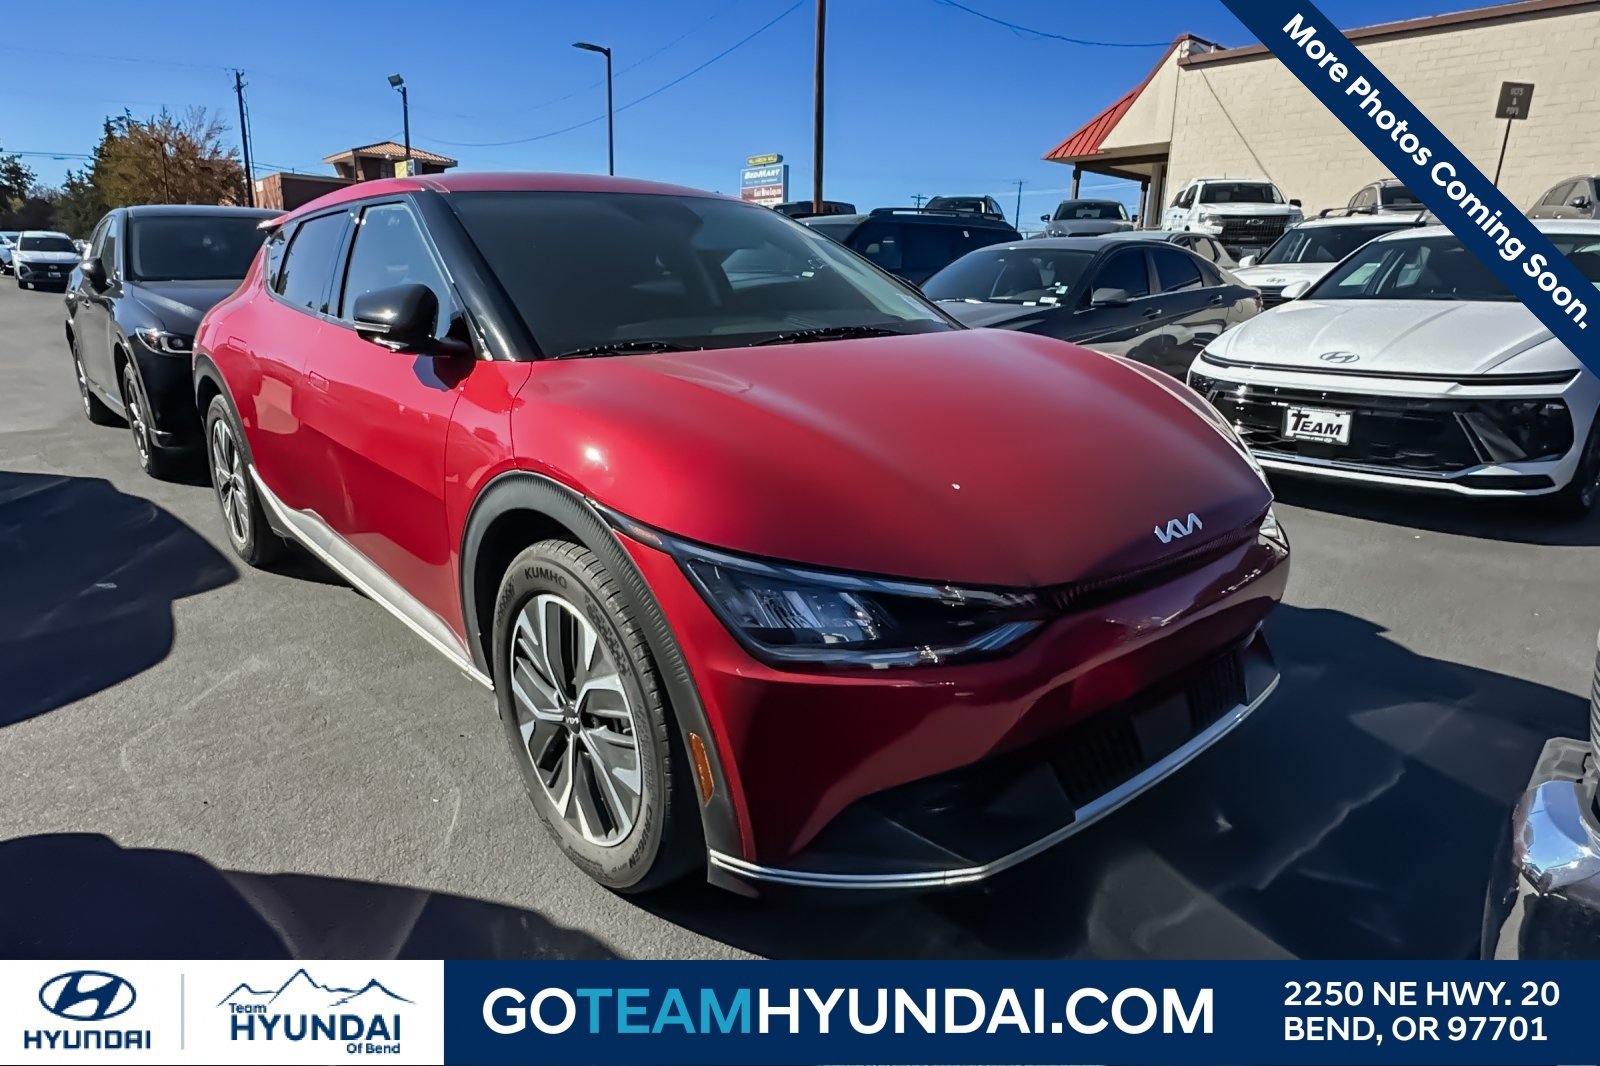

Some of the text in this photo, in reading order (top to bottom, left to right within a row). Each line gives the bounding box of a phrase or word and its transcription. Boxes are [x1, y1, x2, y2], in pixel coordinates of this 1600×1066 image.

[1291, 411, 1343, 436] TEAM
[1154, 512, 1203, 544] KIA
[524, 566, 567, 590] KUMHO
